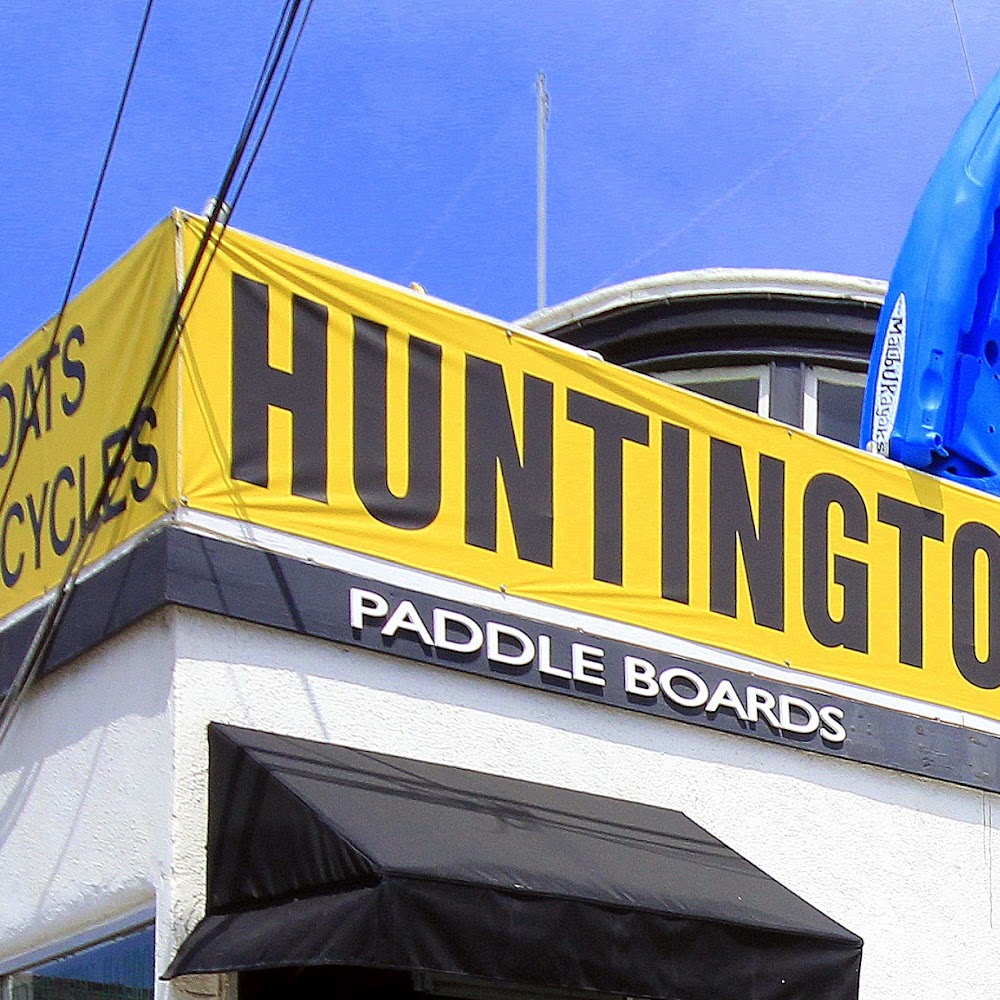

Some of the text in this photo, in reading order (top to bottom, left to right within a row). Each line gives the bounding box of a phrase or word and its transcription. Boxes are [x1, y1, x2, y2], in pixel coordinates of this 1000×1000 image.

[0, 405, 159, 587] CYCLES
[349, 587, 846, 742] PADDLE BOARDS
